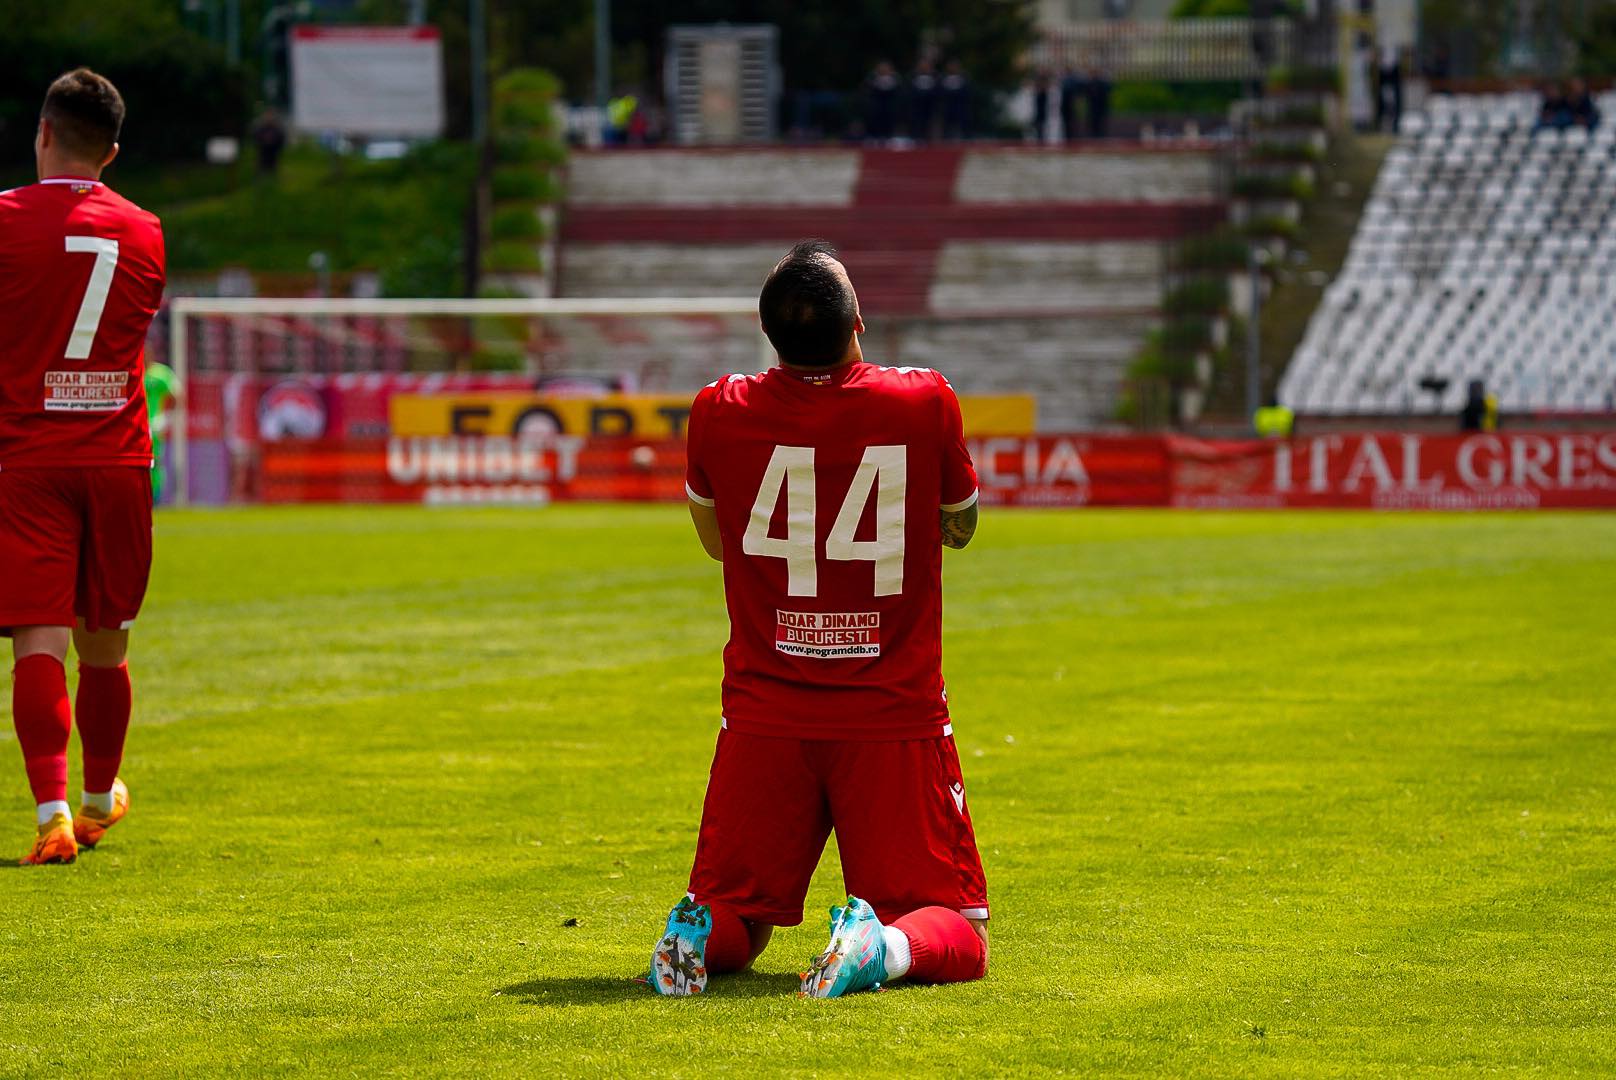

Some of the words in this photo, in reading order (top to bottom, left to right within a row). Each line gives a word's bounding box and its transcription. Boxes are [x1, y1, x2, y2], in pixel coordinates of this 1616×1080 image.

[65, 236, 119, 360] 7
[47, 373, 81, 385] DOAR
[86, 373, 128, 385] DINAMO
[387, 435, 584, 484] UNIBET
[1272, 434, 1446, 492] ITAL
[743, 444, 907, 597] 44
[778, 611, 816, 628] DOAR
[821, 613, 878, 628] DINAMO
[777, 643, 879, 657] www.programddb.ro
